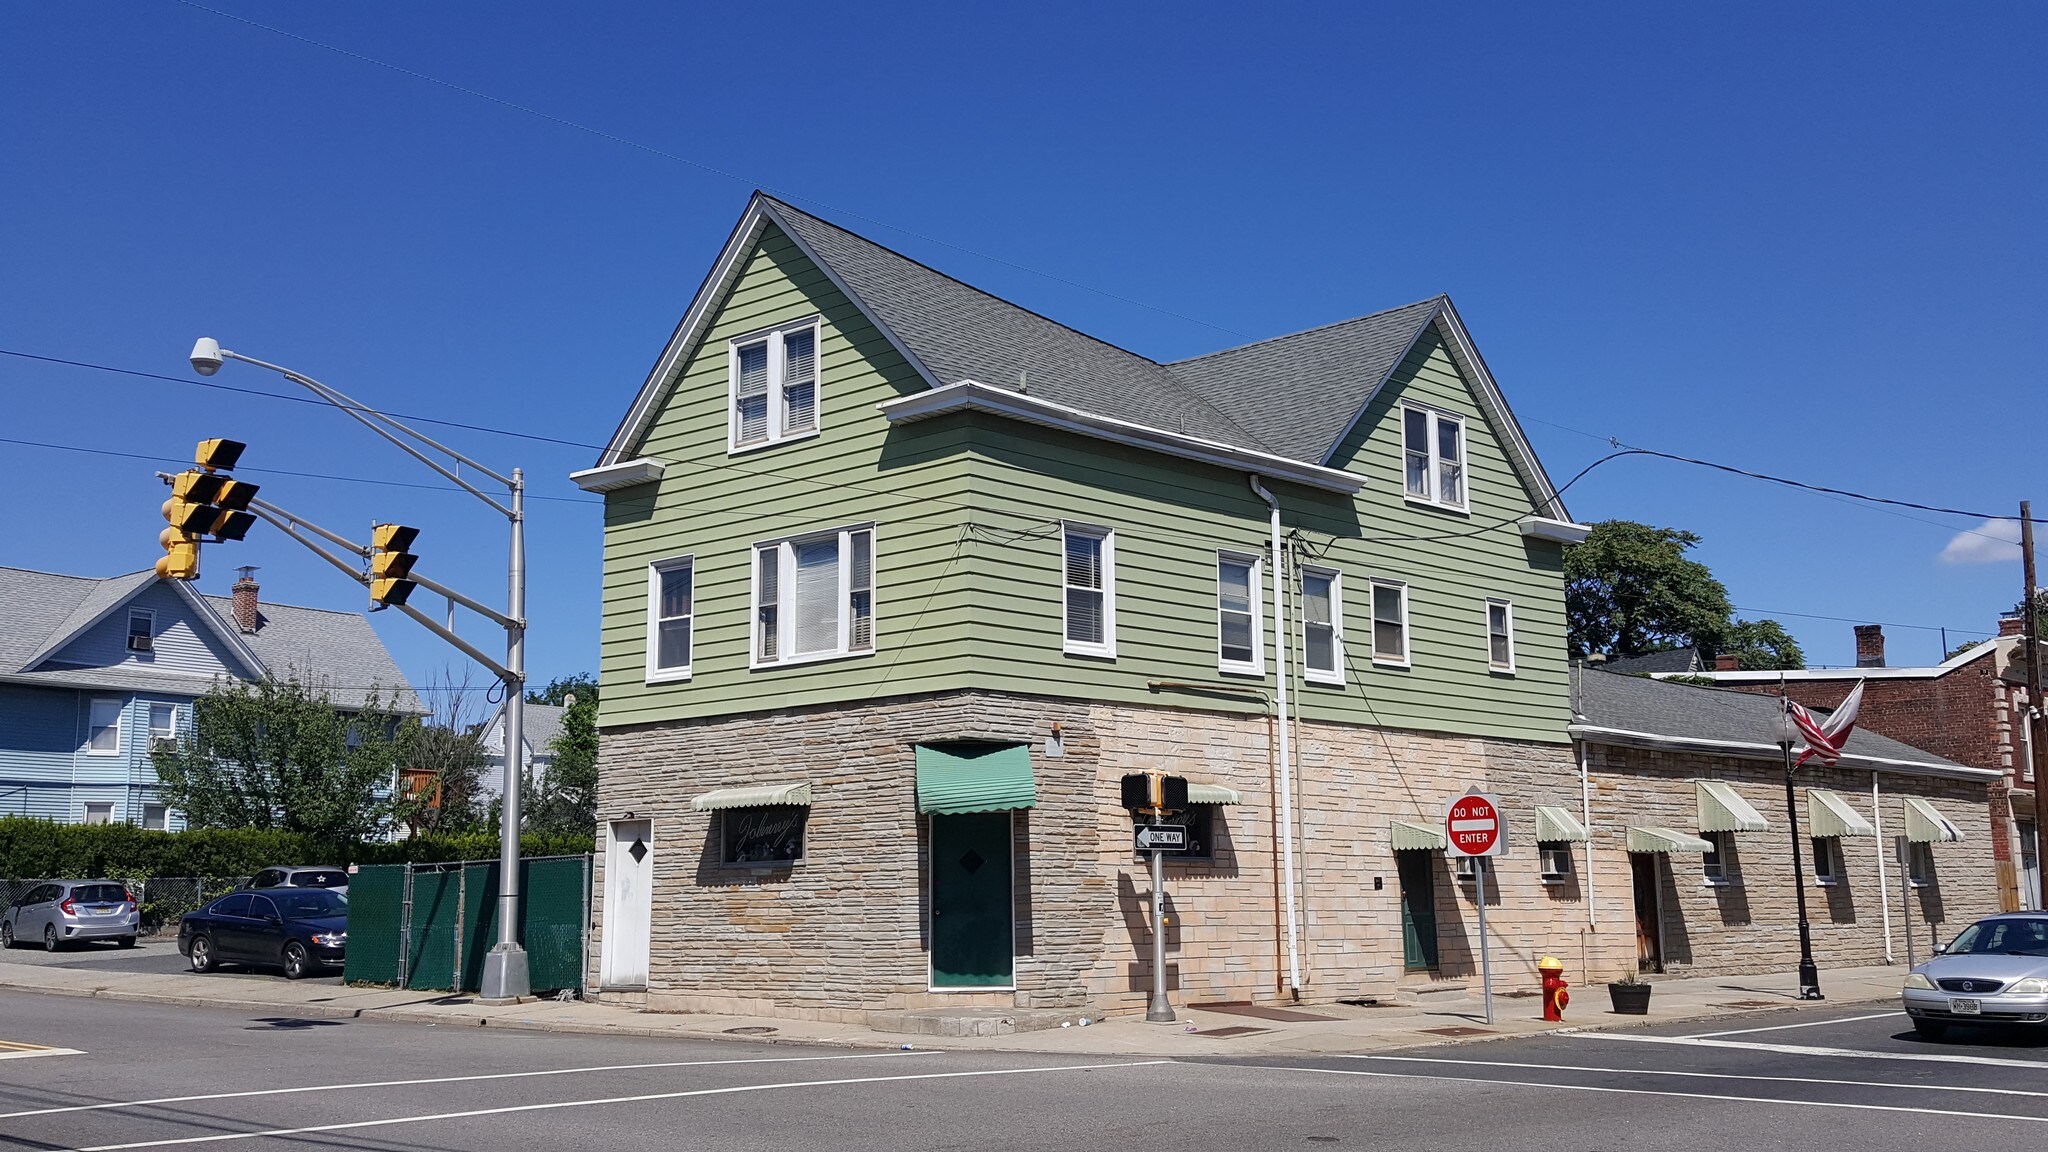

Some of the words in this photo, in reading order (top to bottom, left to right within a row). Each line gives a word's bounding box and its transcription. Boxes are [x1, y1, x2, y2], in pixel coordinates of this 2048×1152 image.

[1453, 807, 1466, 818] DO
[1472, 806, 1489, 817] NOT
[735, 811, 798, 852] Johnny's
[1149, 832, 1164, 842] ONE
[1166, 832, 1181, 842] WAY
[1459, 833, 1488, 844] ENTER
